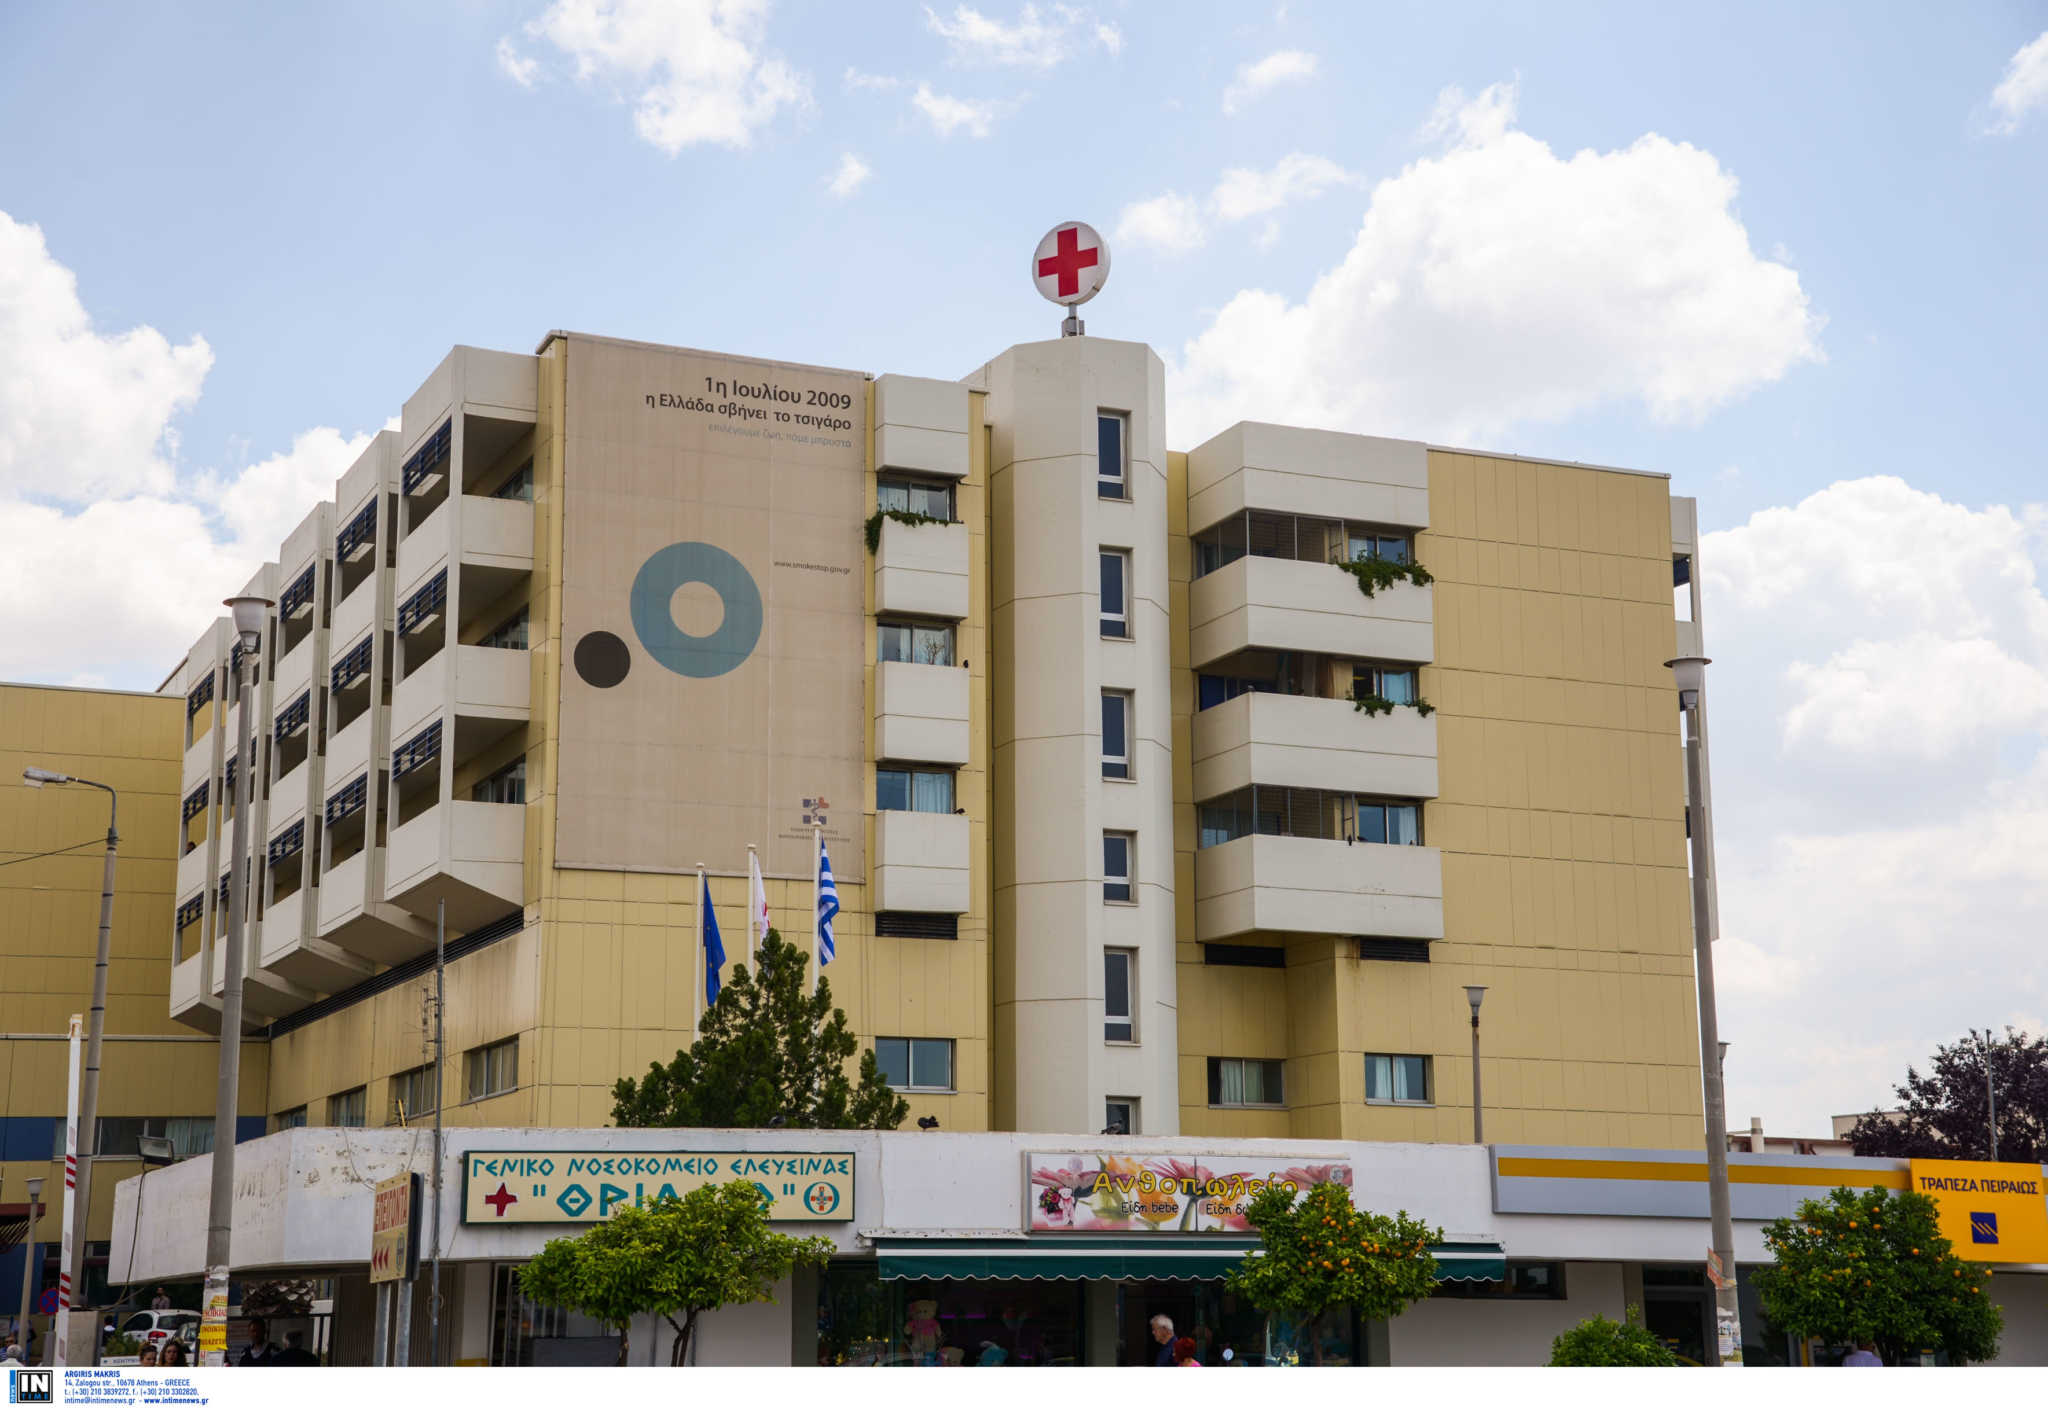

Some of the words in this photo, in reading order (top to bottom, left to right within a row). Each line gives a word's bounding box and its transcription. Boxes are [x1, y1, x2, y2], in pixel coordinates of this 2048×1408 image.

[705, 377, 728, 399] 1η
[733, 380, 801, 404] Ιουλίου
[807, 390, 851, 410] 2009
[645, 395, 656, 409] η
[659, 393, 714, 413] Ελλάδα
[718, 402, 768, 421] σβήνει
[774, 411, 791, 423] το
[794, 413, 852, 431] τσιγάρο
[473, 1158, 555, 1177] ΓΕΝΙΚΟ
[567, 1157, 718, 1177] ΝΟΣΟΚΟΜΕΙΟ
[730, 1157, 849, 1176] ΕΛΕΥΣΙΝΑΣ
[1092, 1171, 1298, 1200] Ανθοπωλείο
[1920, 1177, 1979, 1192] ΤΡΑΠΕΖΑ
[1980, 1179, 2039, 1194] ΠΕΙΡΑΙΩΣ
[1121, 1201, 1147, 1215] Είδη
[1152, 1201, 1179, 1214] bebe
[1206, 1203, 1231, 1215] Είδη
